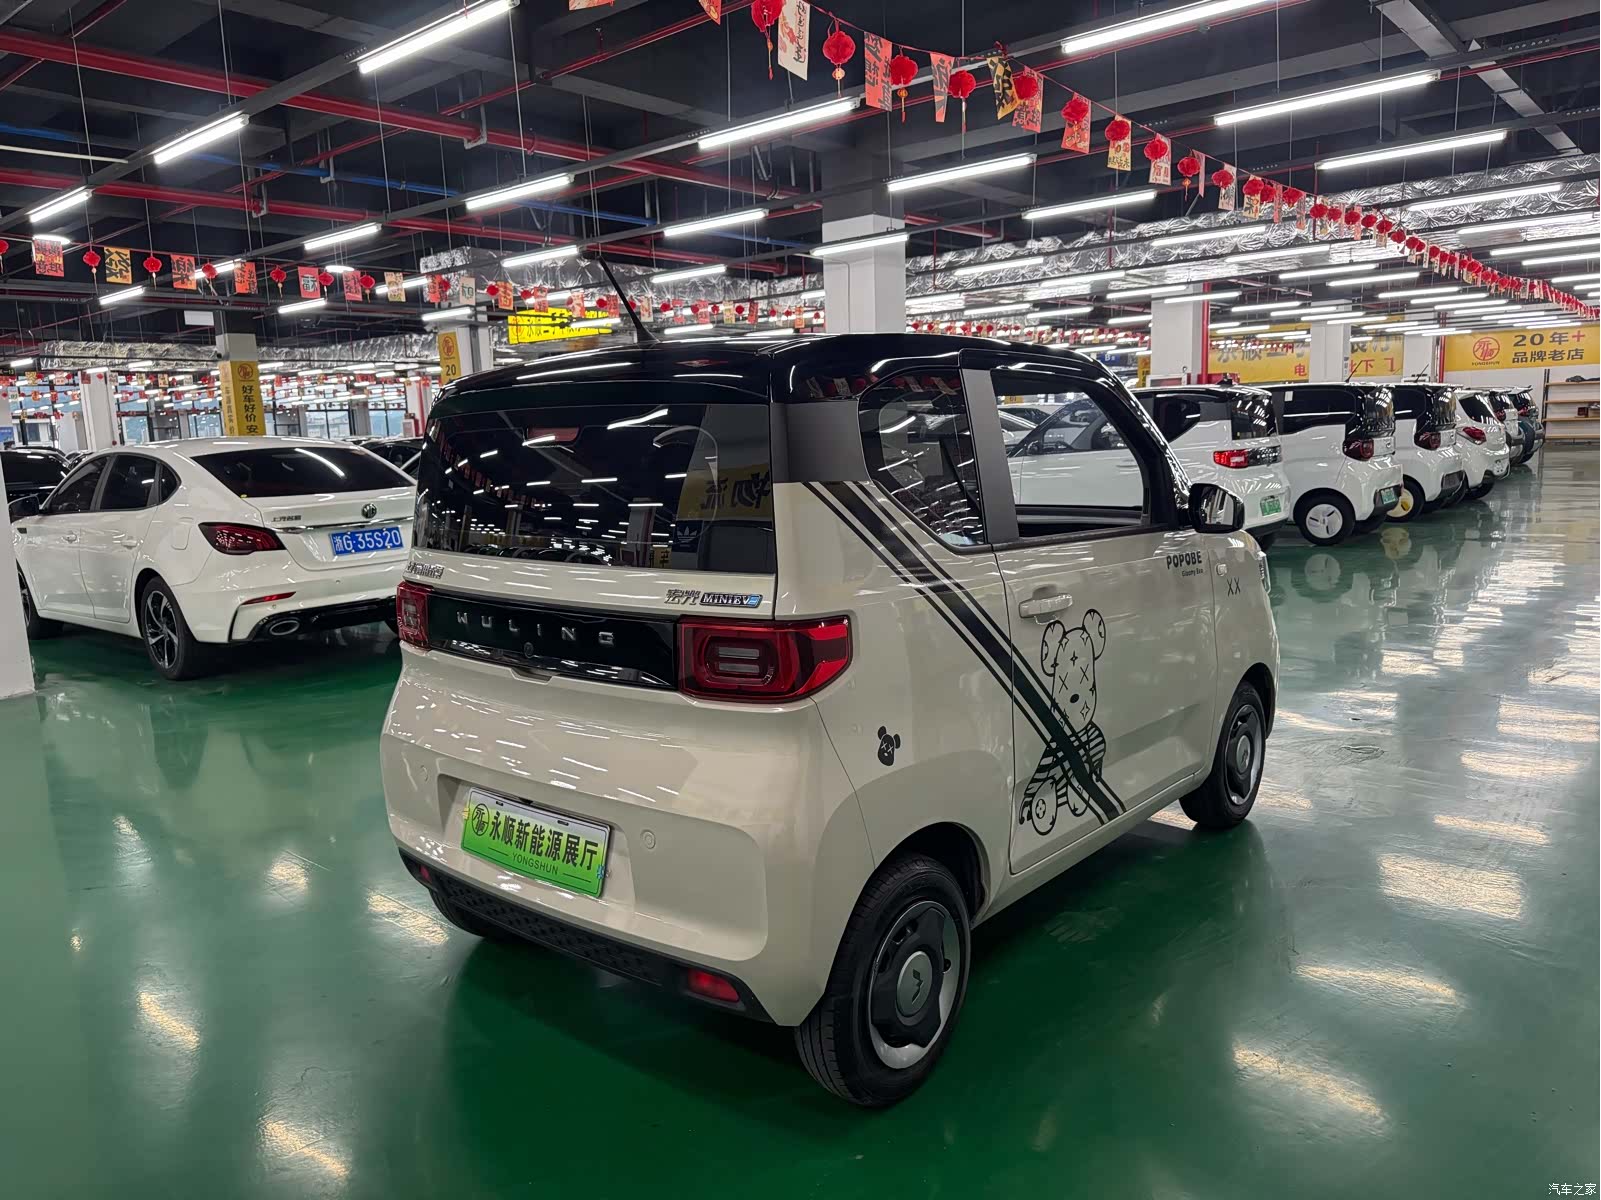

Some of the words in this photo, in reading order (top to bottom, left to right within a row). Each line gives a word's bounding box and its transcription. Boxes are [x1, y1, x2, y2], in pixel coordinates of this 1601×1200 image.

[1512, 348, 1585, 364] 品牌老店
[446, 364, 457, 376] 20
[1295, 364, 1307, 377] 电
[242, 385, 256, 422] 好车好价
[1166, 551, 1203, 570] POPOBE
[456, 611, 614, 646] WULING
[489, 811, 599, 871] 永顺新能源展厅
[512, 852, 559, 876] YONGSHUN
